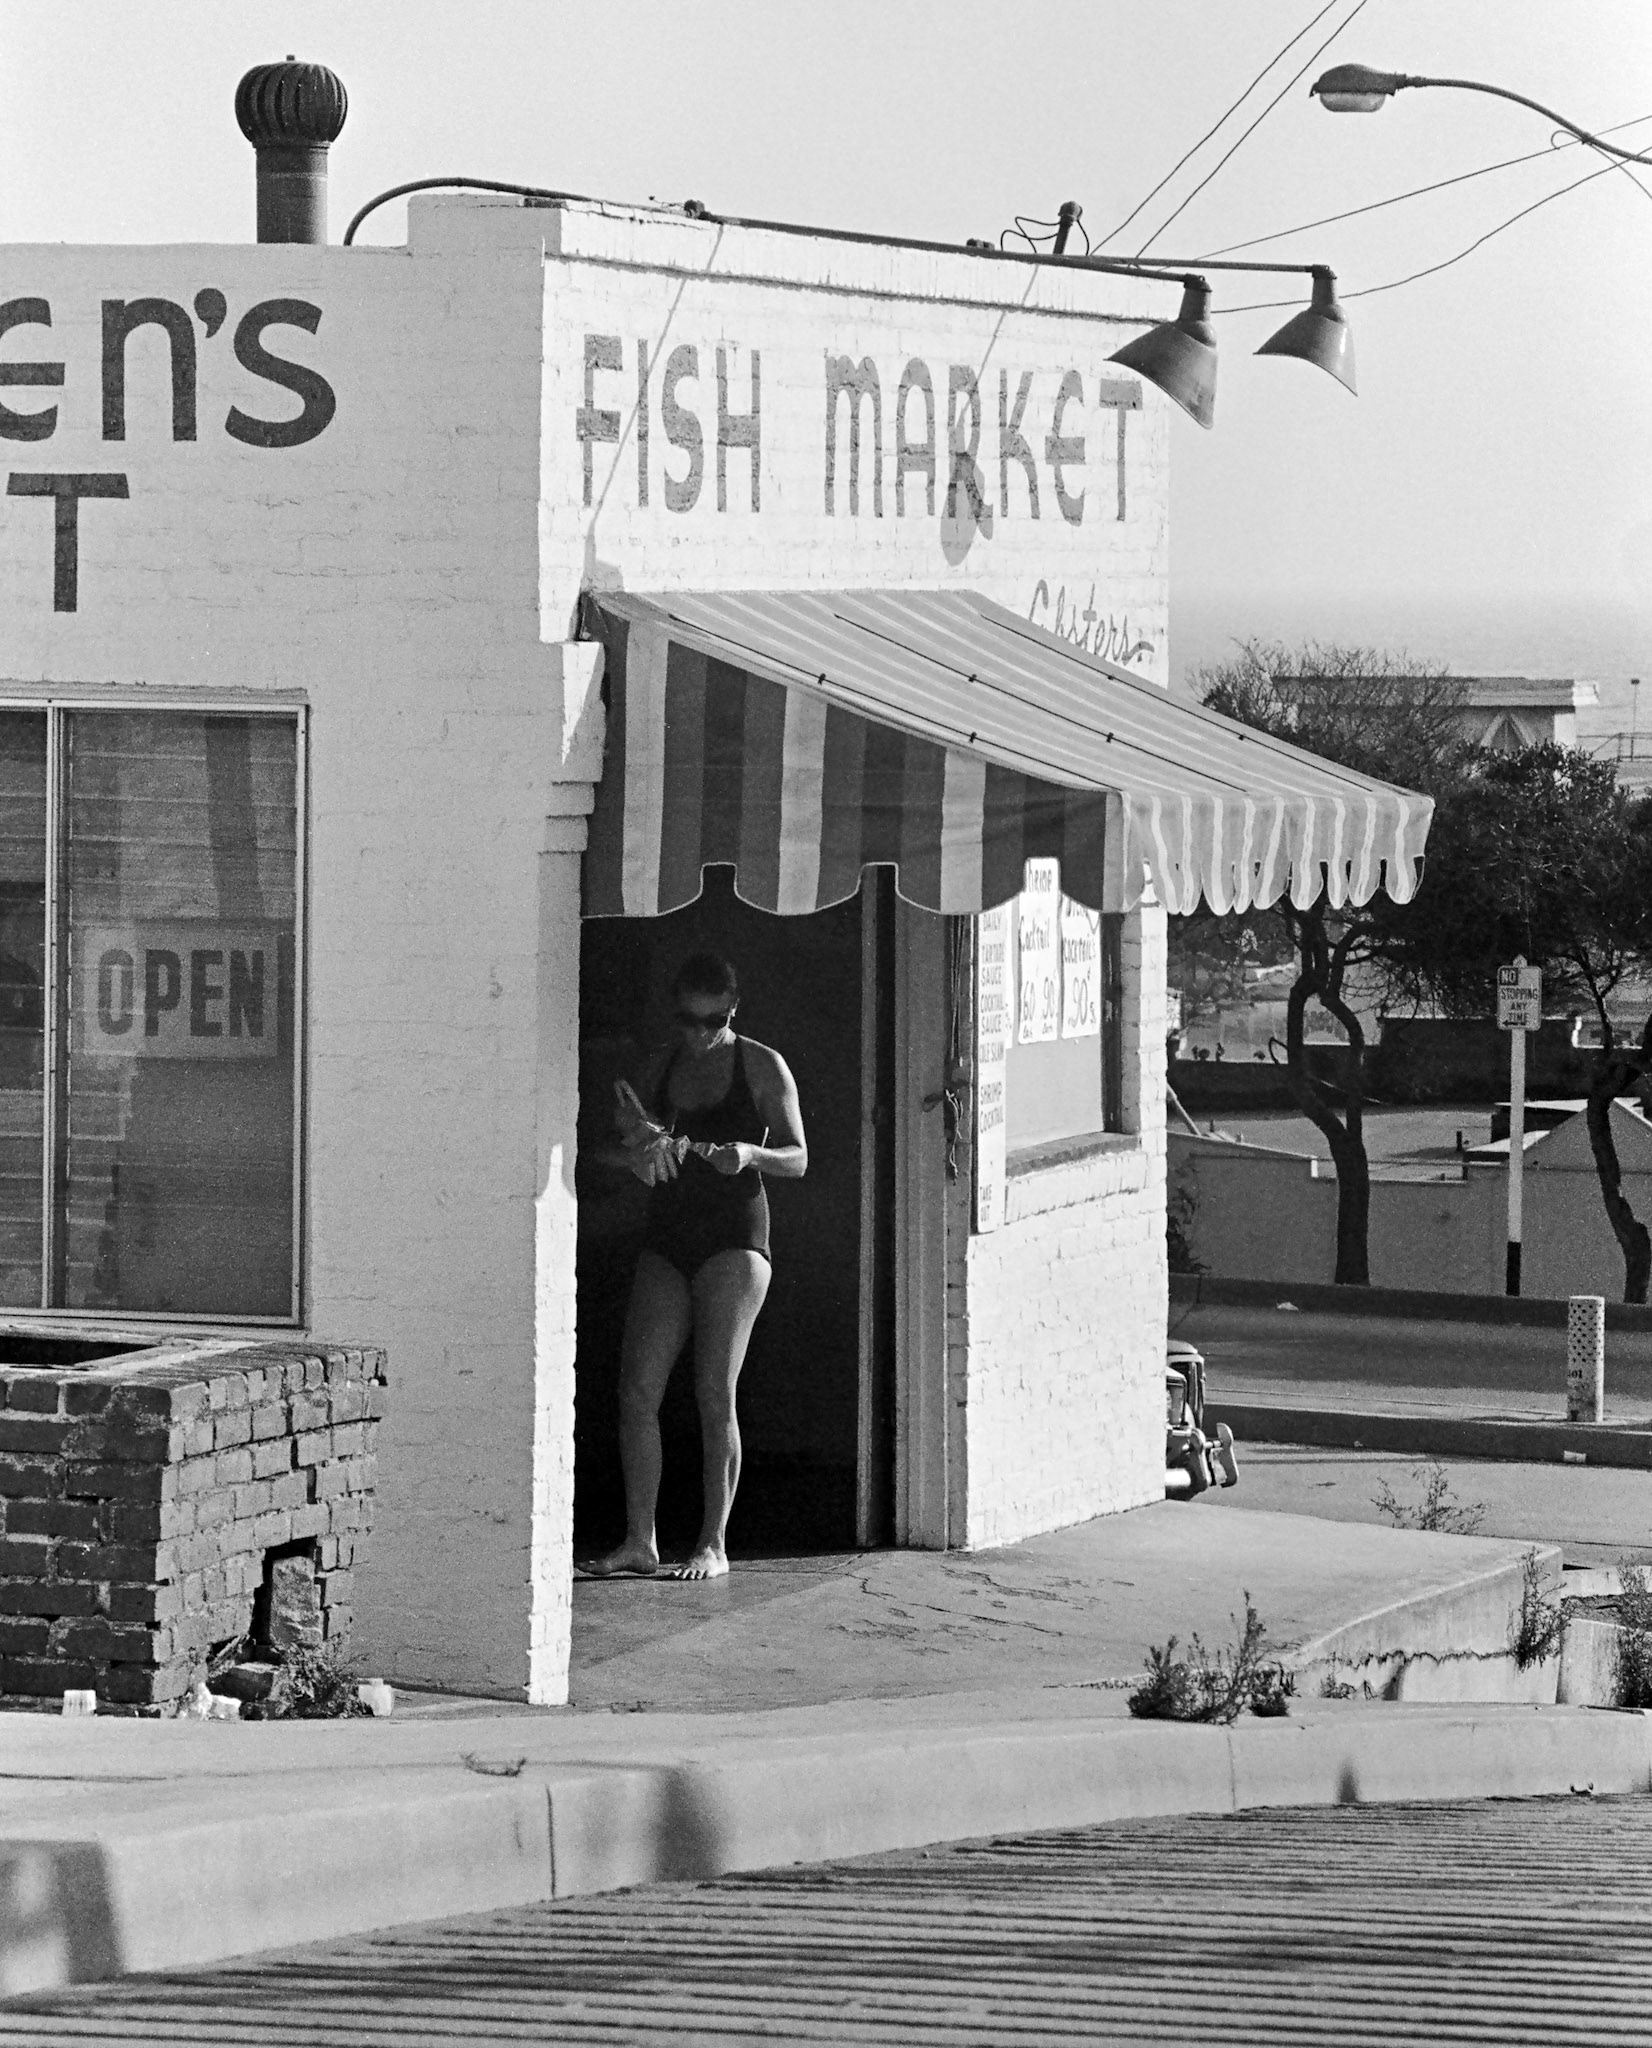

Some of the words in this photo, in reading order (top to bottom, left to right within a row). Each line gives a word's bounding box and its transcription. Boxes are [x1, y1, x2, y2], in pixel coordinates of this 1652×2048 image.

[575, 333, 761, 514] FISH
[823, 346, 1143, 527] MARKET
[981, 966, 1002, 987] SAUCE
[1501, 969, 1517, 984] NO
[96, 947, 265, 1039] OPEN
[1500, 987, 1539, 1000] STOPPING
[1510, 1001, 1528, 1011] ANY
[981, 1014, 1002, 1035] SAUCE
[1508, 1012, 1529, 1023] TIME
[980, 1081, 1003, 1105] SHRIMP
[980, 1105, 1004, 1134] COCKTAIL
